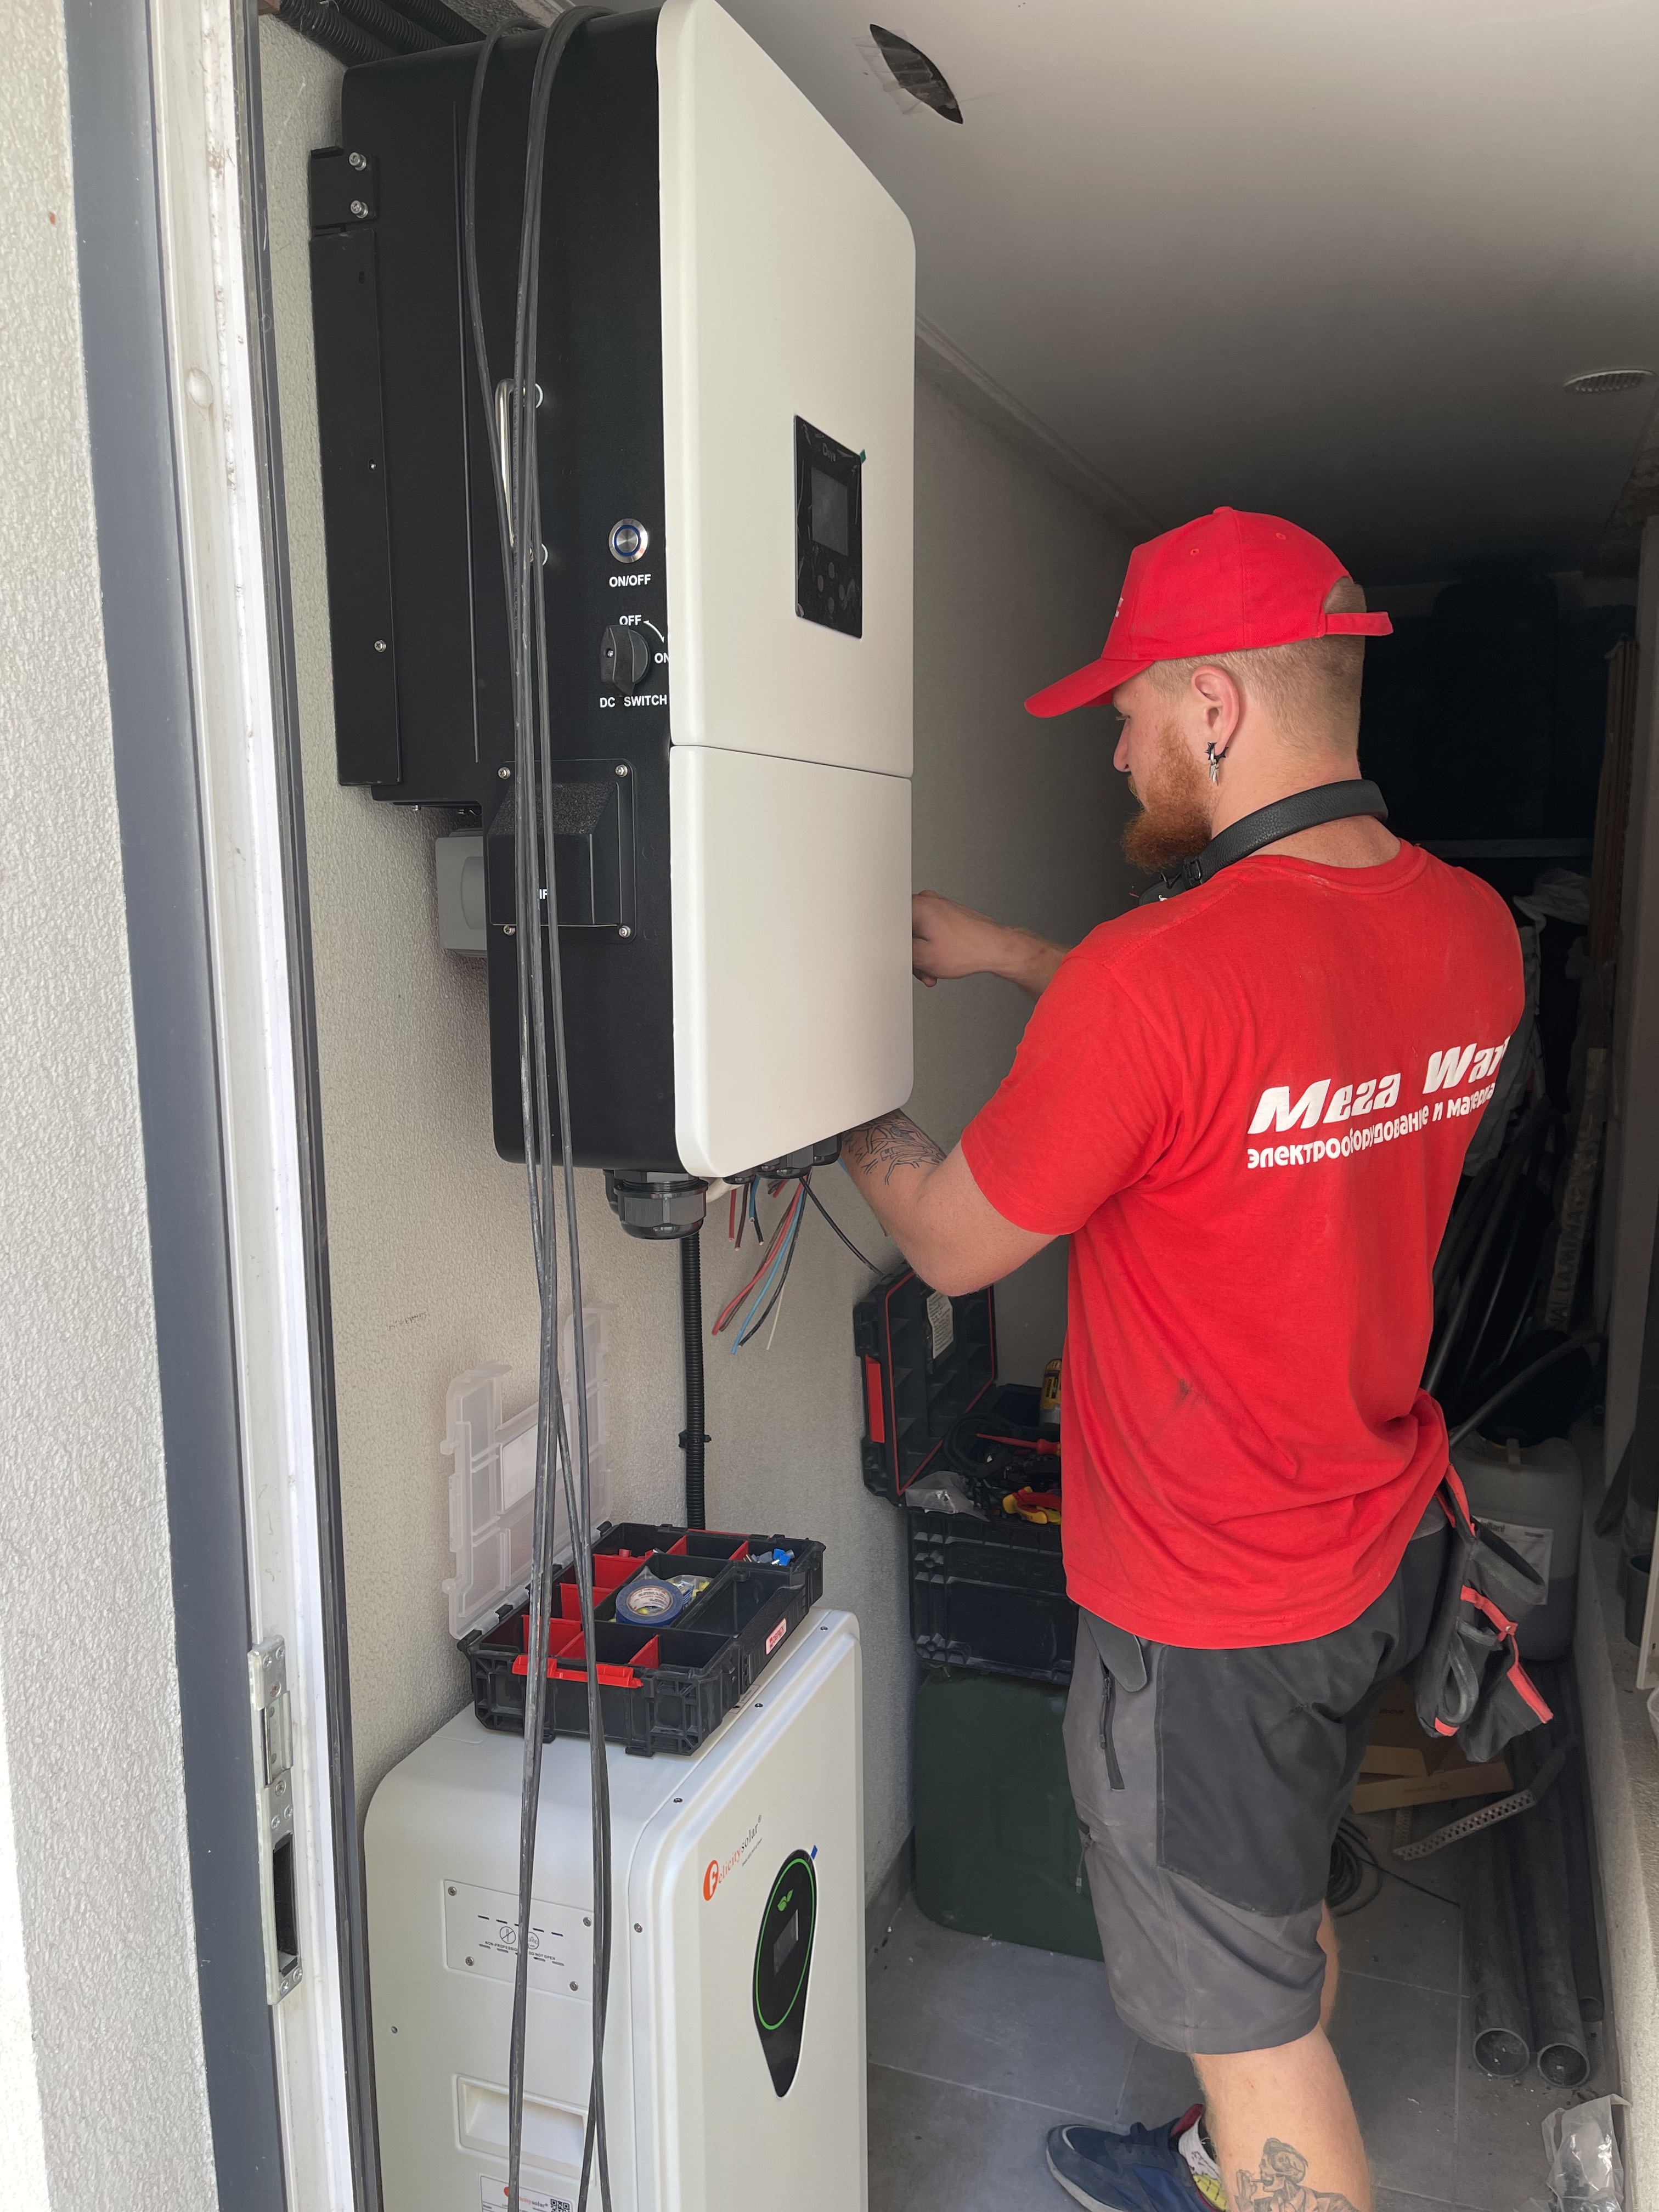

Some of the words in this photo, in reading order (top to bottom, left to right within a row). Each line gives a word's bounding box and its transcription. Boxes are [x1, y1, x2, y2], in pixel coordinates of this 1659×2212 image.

[609, 574, 651, 588] ON/OFF
[619, 614, 642, 626] OFF
[654, 653, 669, 664] ON
[600, 697, 616, 708] DC
[624, 694, 667, 707] SWITCH
[1432, 1102, 1443, 1121] и
[485, 1940, 518, 1951] NON-PROFESSIO
